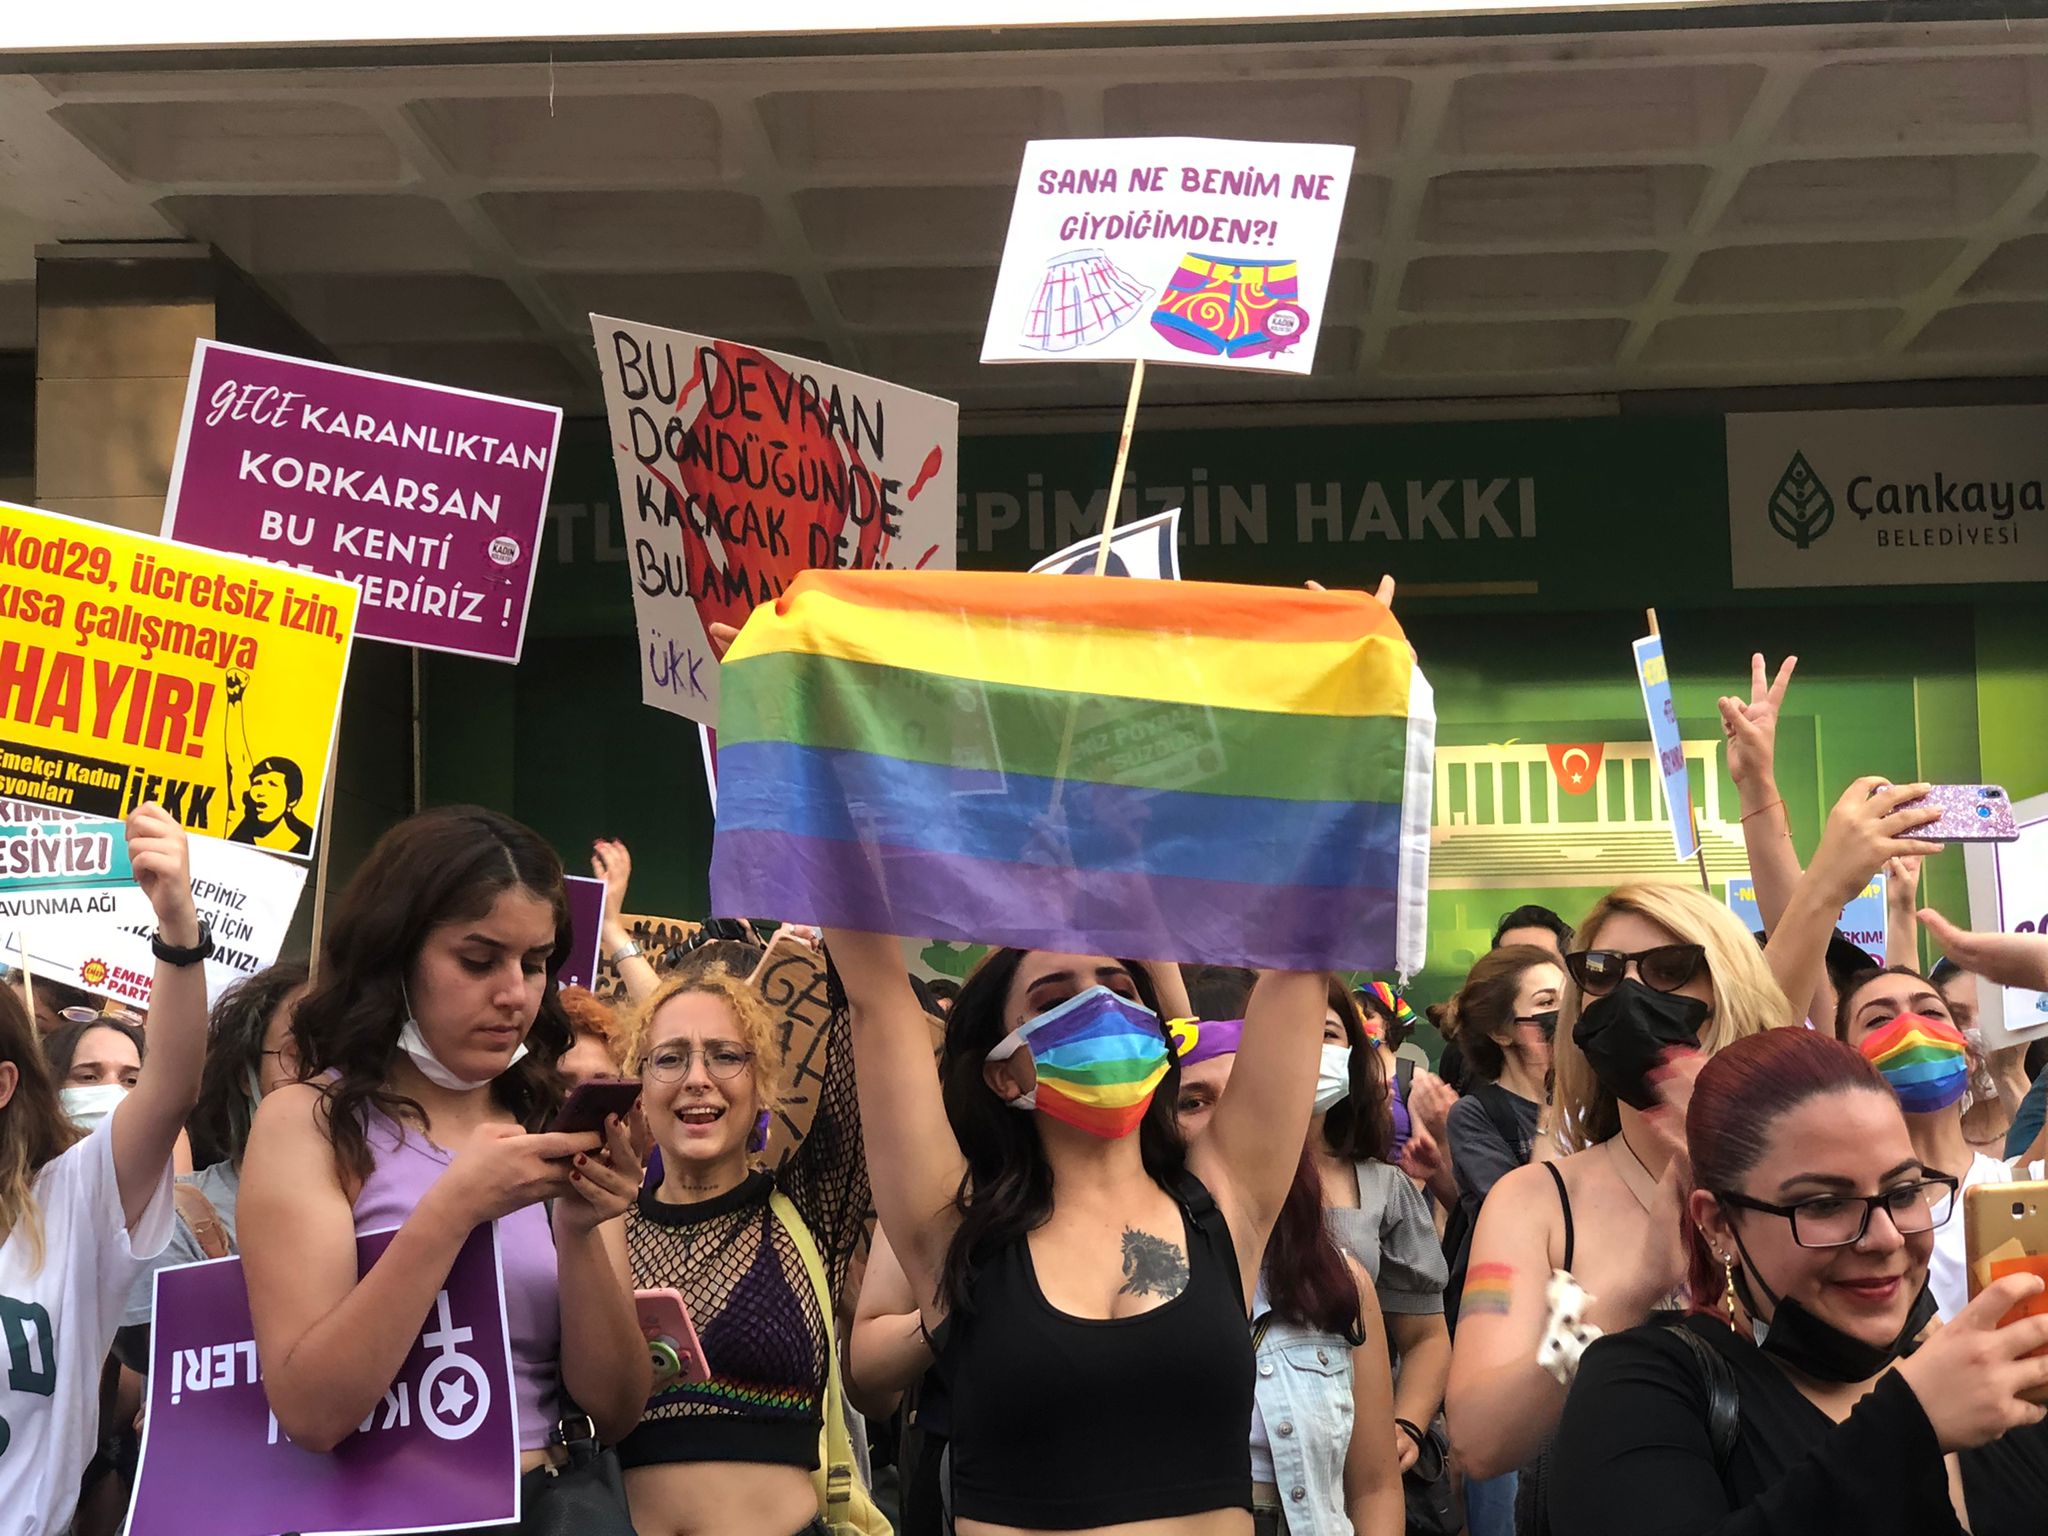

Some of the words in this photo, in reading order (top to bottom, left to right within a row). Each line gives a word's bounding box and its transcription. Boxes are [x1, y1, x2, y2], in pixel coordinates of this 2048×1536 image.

[1038, 168, 1118, 195] SANA
[1128, 167, 1168, 192] NE
[1181, 166, 1280, 198] BENİM
[1291, 174, 1335, 201] NE
[1060, 209, 1278, 247] GİYDİĞİMDEN?!
[205, 379, 306, 429] GECE
[300, 402, 548, 473] KARANLIKTAN
[613, 331, 678, 406] BU
[699, 346, 885, 462] DEVRAN
[238, 449, 502, 525] KORKARSAN
[628, 406, 904, 540] DÖNDÜĞÜNDE
[1846, 471, 2047, 520] Çankaya
[260, 510, 316, 547] BU
[1296, 477, 1536, 545] HAKKI
[1877, 523, 2019, 548] BELEDİYESİ
[0, 525, 118, 593] Kod29,
[130, 553, 279, 622] ücretsiz
[280, 587, 344, 644] izin,
[75, 600, 259, 671] çalışmaya
[649, 628, 709, 702] ÜKK
[0, 641, 217, 759] HAYIR!
[65, 761, 121, 791] Kadın
[86, 892, 116, 914] AĞI
[220, 912, 253, 942] İÇİN
